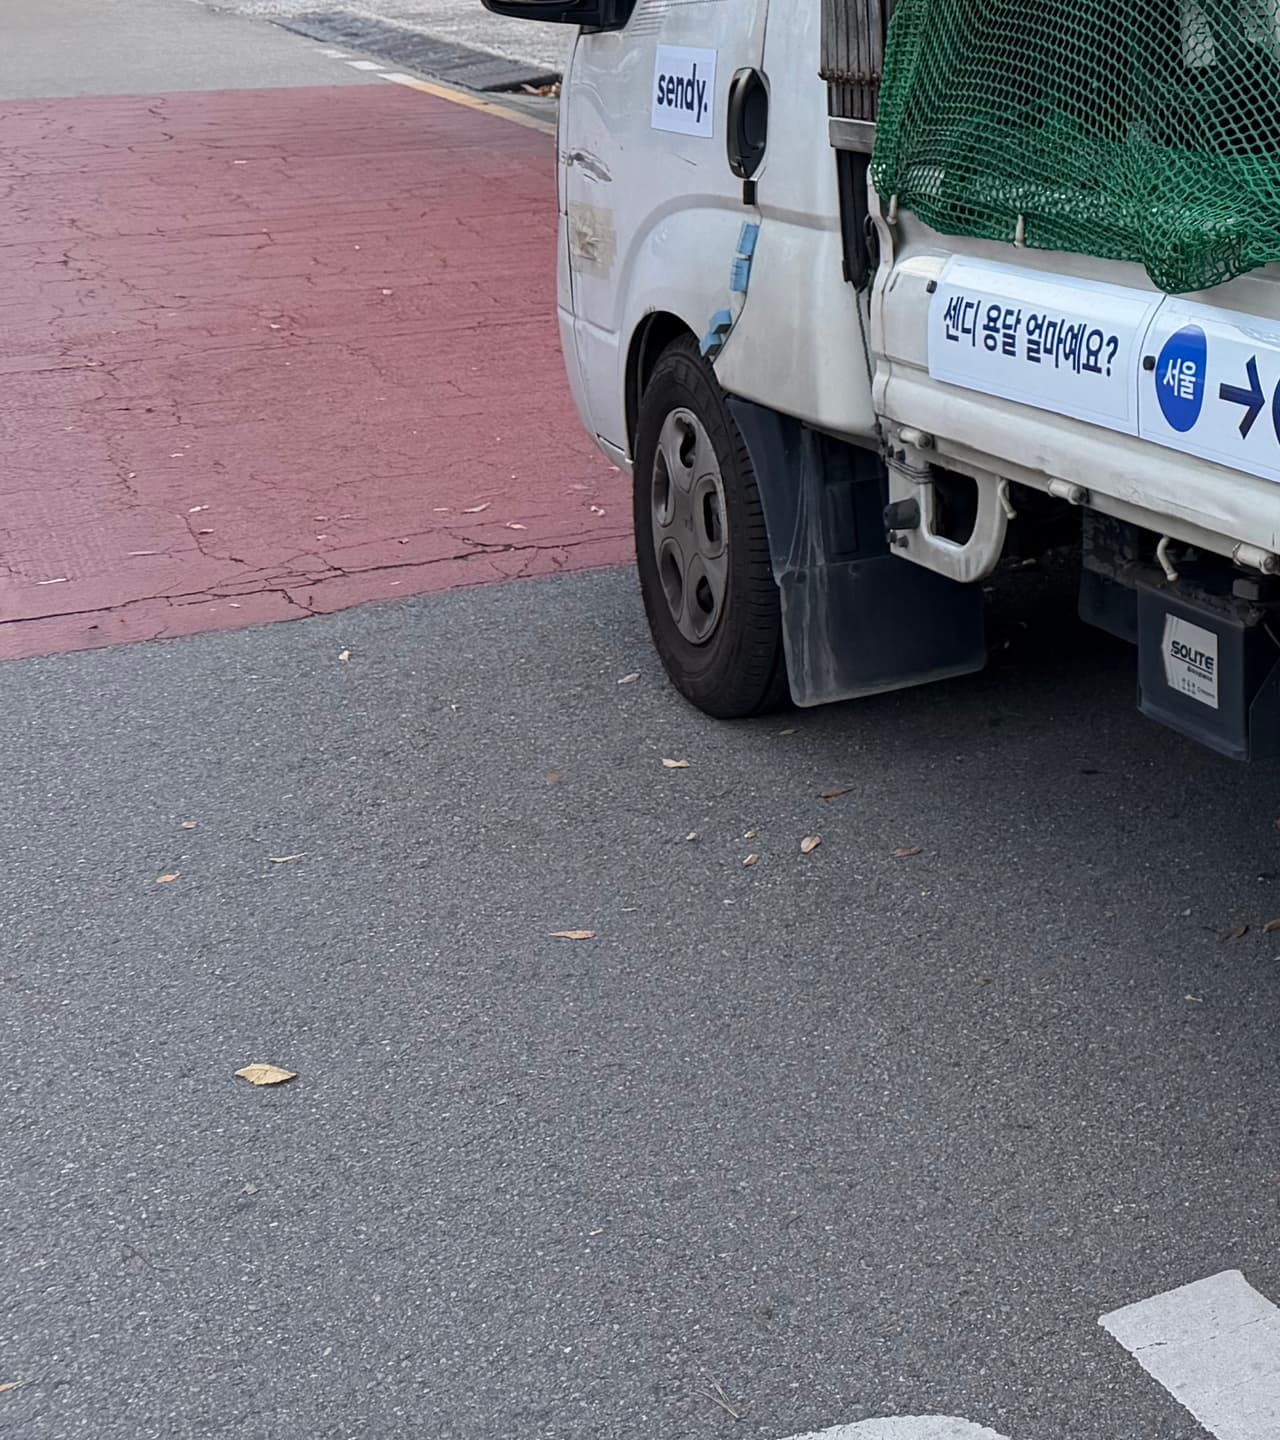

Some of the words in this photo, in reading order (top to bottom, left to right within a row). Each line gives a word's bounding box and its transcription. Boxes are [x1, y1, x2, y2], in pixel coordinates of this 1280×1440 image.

[657, 63, 708, 123] sendy.
[943, 296, 980, 347] 센디
[982, 303, 1022, 357] 용달
[1026, 313, 1119, 378] 얼마예요?
[1163, 357, 1196, 400] 서울
[1171, 640, 1214, 670] SOLITE
